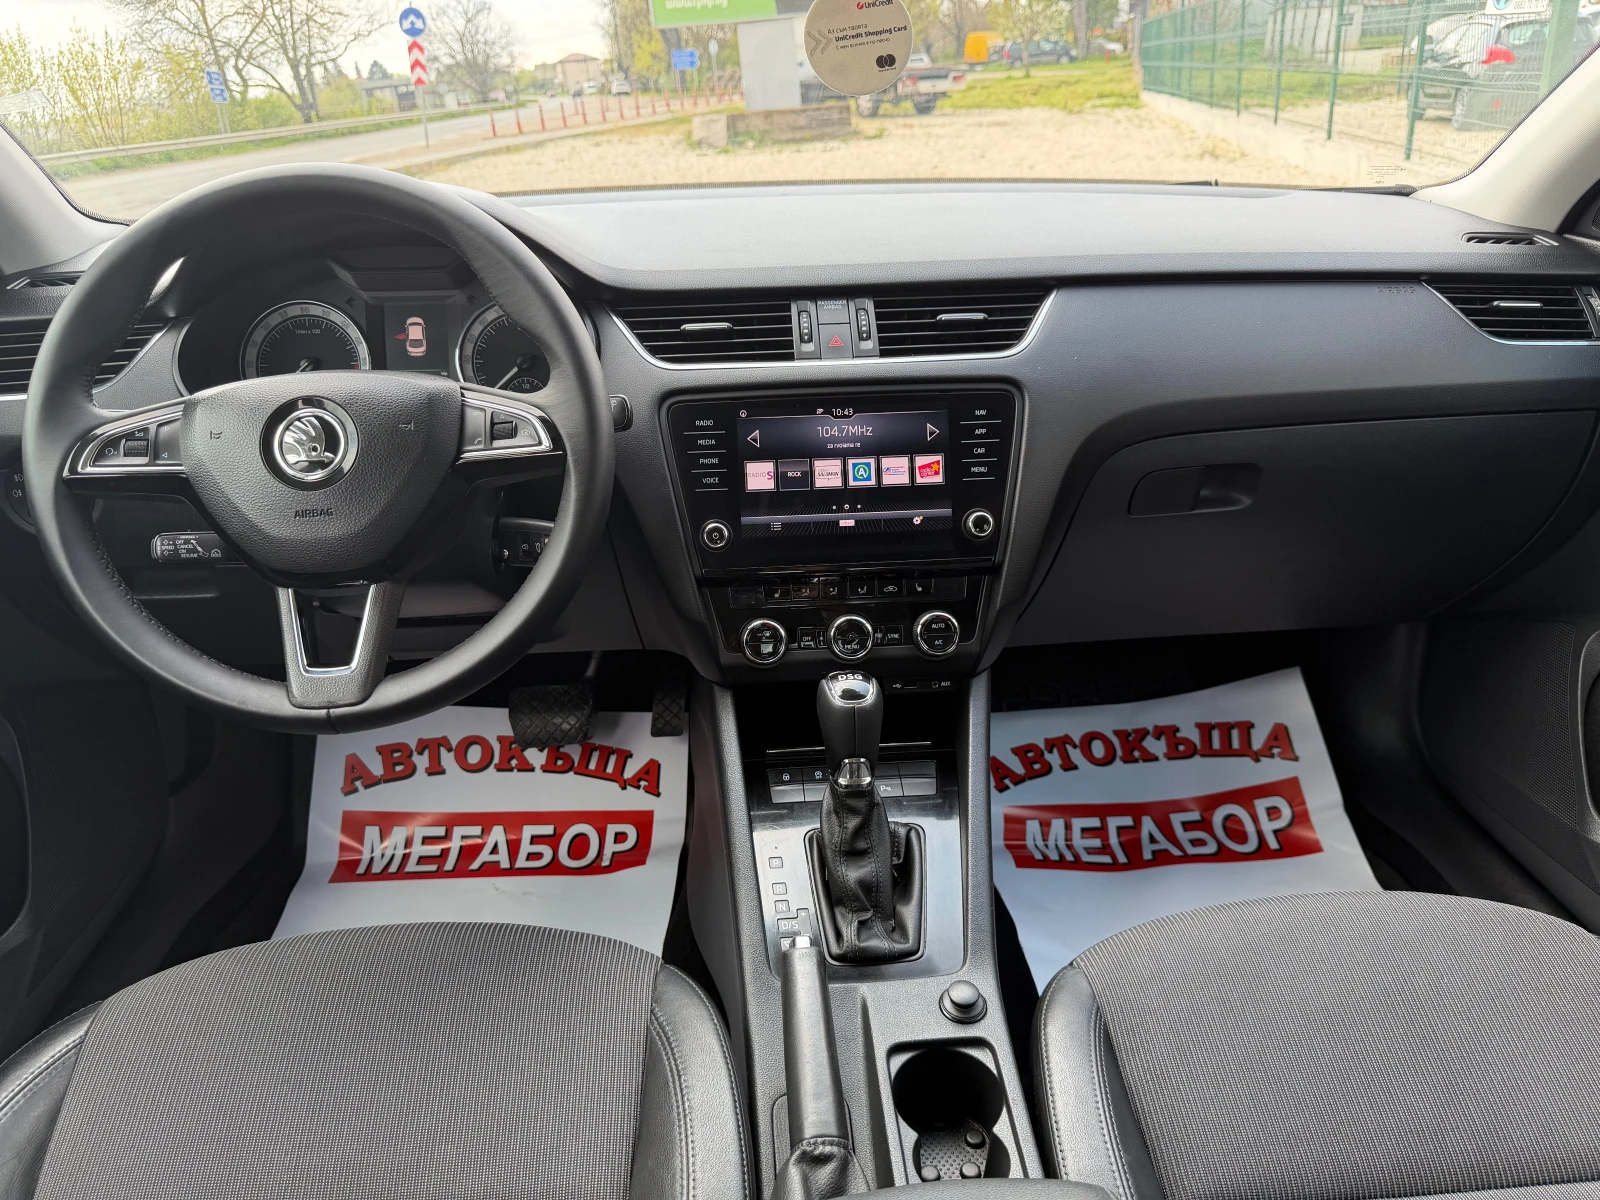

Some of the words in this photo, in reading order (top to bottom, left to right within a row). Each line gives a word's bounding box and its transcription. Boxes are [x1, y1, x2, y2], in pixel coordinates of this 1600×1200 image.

[864, 0, 894, 9] UniCredit
[834, 32, 864, 42] UniCredit
[864, 27, 893, 38] Shopping
[893, 24, 908, 33] Card
[831, 407, 854, 416] 10:43
[816, 424, 873, 438] 104.7MHz
[294, 508, 333, 519] AIRBAG
[837, 673, 863, 681] DSG
[990, 720, 1300, 793] АВТОКЪЩА
[341, 734, 661, 798] АВТОКЪЩА
[1024, 795, 1296, 865] МЕГАБОР
[355, 822, 640, 876] МЕГАБОР
[781, 920, 798, 929] D/S
